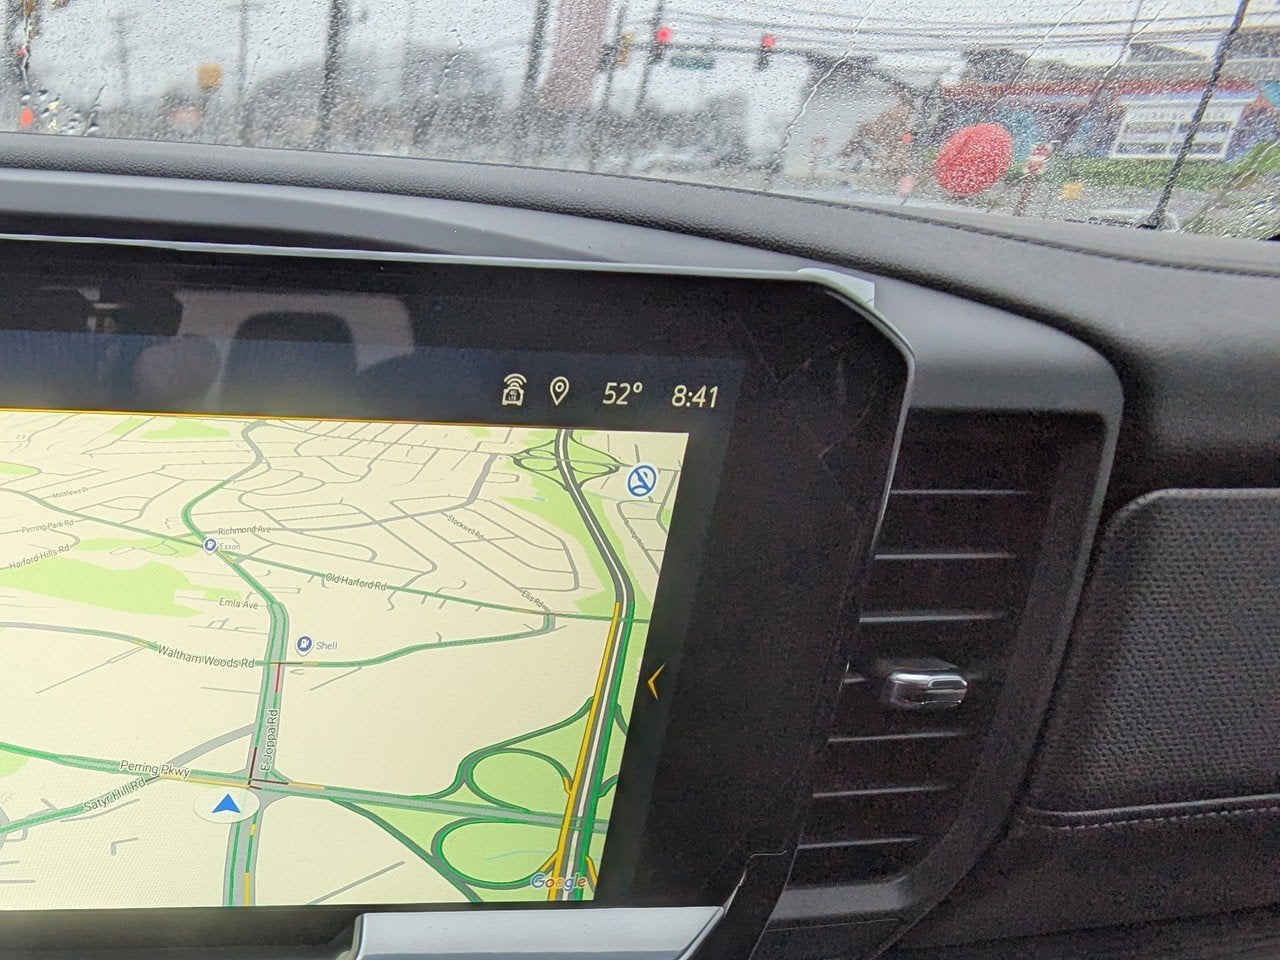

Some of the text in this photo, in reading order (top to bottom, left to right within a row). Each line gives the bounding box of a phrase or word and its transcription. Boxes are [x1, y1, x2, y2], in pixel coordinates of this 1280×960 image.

[602, 382, 643, 405] 52°
[671, 385, 719, 408] 8:41
[21, 524, 47, 533] Perring
[48, 521, 62, 529] Park
[218, 526, 271, 535] Richmond Ave
[447, 514, 485, 540] Stockwell Rd
[9, 544, 70, 570] Harford Hills Rd
[326, 572, 387, 591] Old Harford Rd
[242, 600, 259, 610] Ave
[522, 589, 544, 608] Ellis Rd
[316, 641, 338, 651] Shell
[158, 644, 255, 668] Waltham Woods Rd
[267, 709, 279, 724] Rd
[264, 725, 278, 762] Joppa
[120, 760, 190, 779] Perring Pkwy
[83, 778, 147, 812] Satyr Hill Rd
[531, 873, 587, 891] Google
